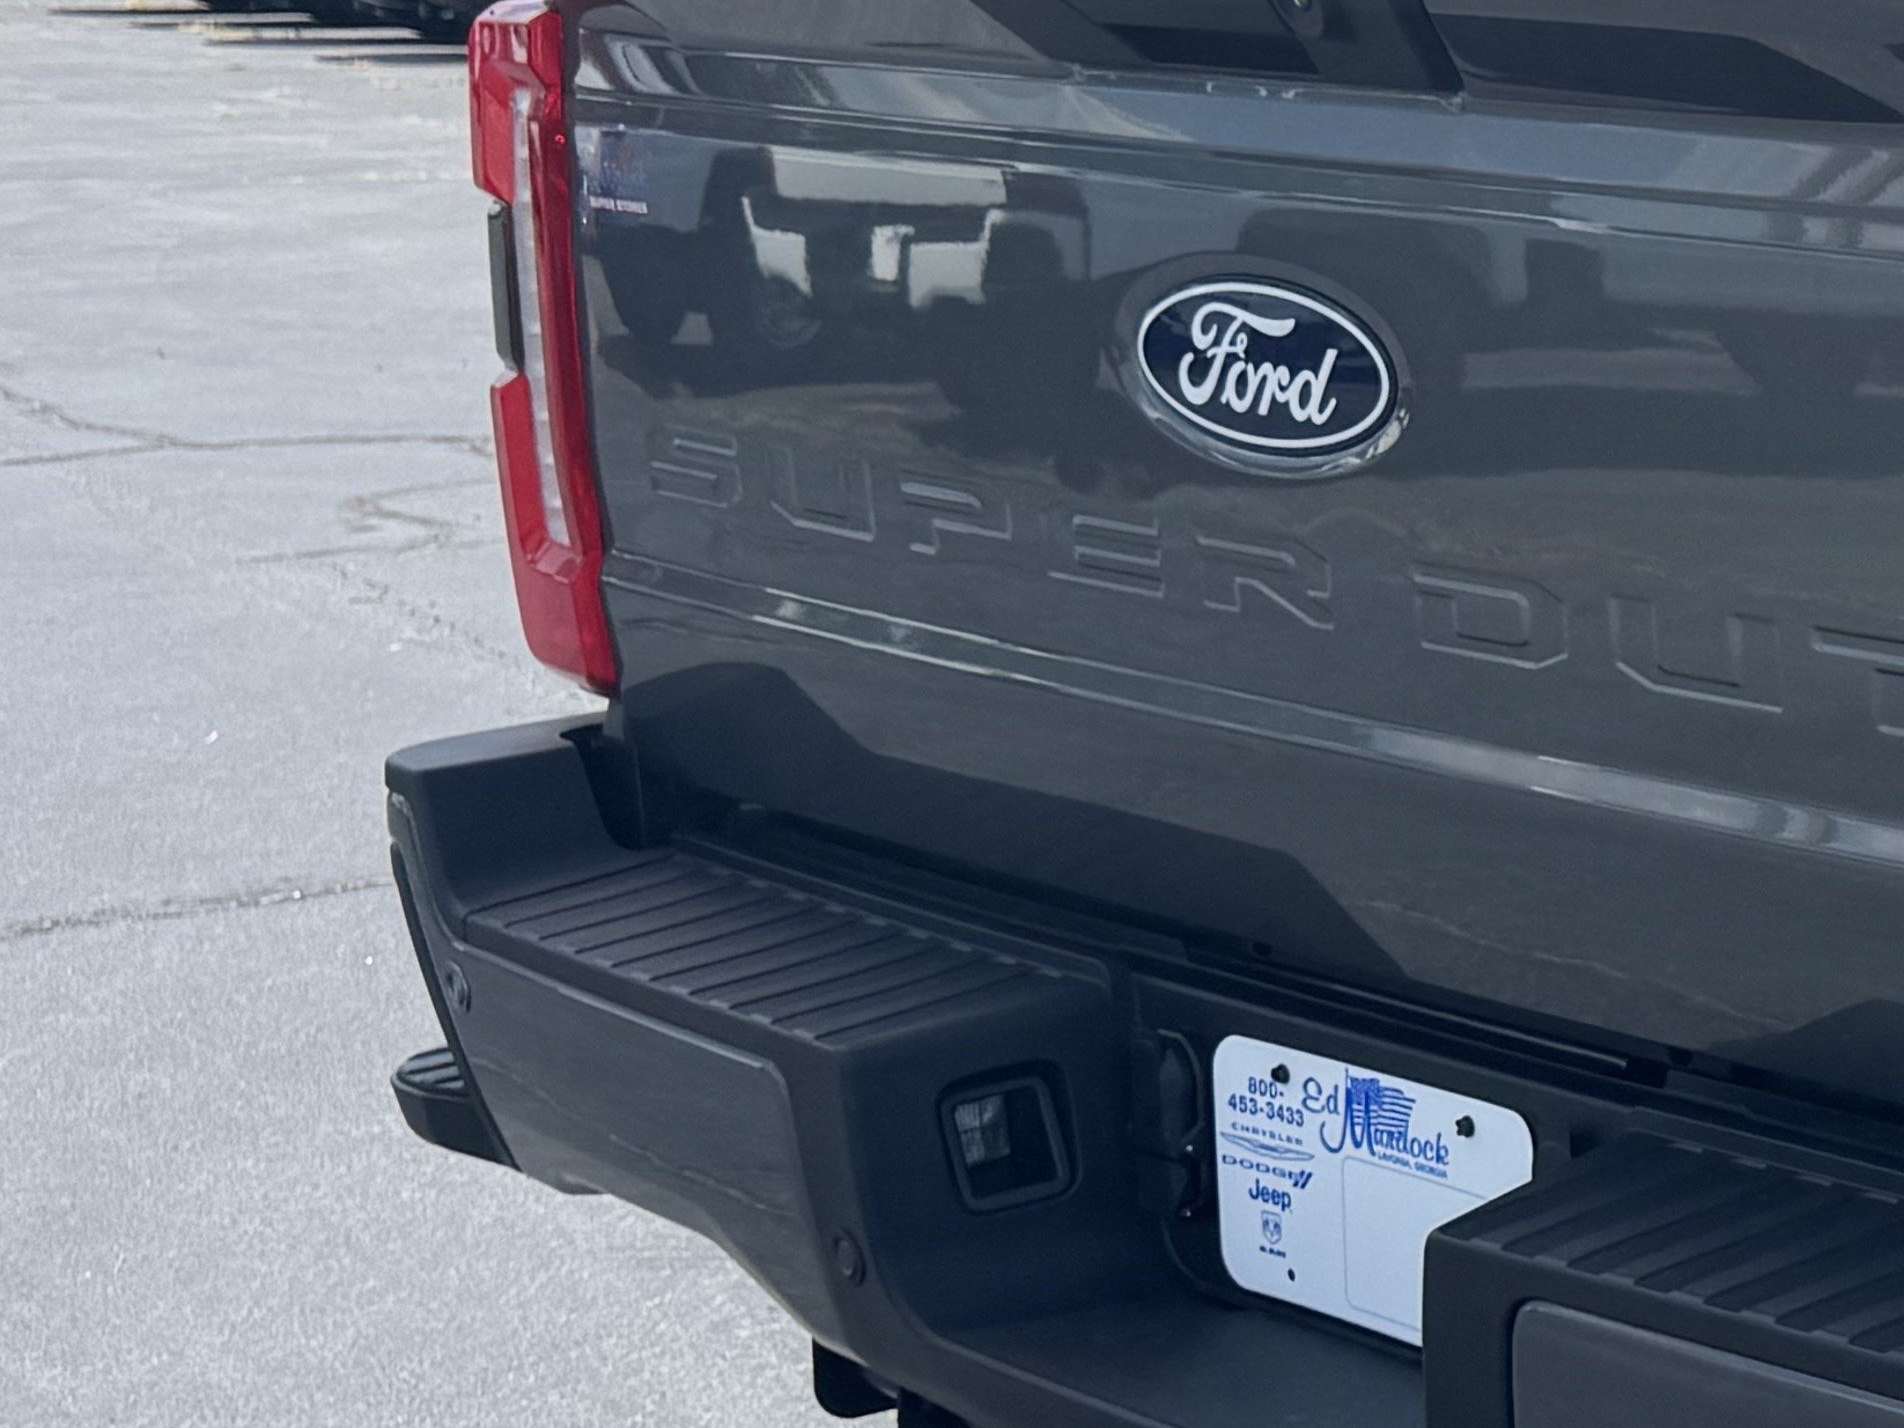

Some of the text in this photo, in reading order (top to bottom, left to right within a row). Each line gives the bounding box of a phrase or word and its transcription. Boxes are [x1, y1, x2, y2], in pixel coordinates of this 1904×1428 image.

[1178, 301, 1338, 425] Ford
[648, 424, 1335, 632] SUPER
[1301, 1076, 1341, 1115] Ed
[1248, 1178, 1292, 1212] Jeep
